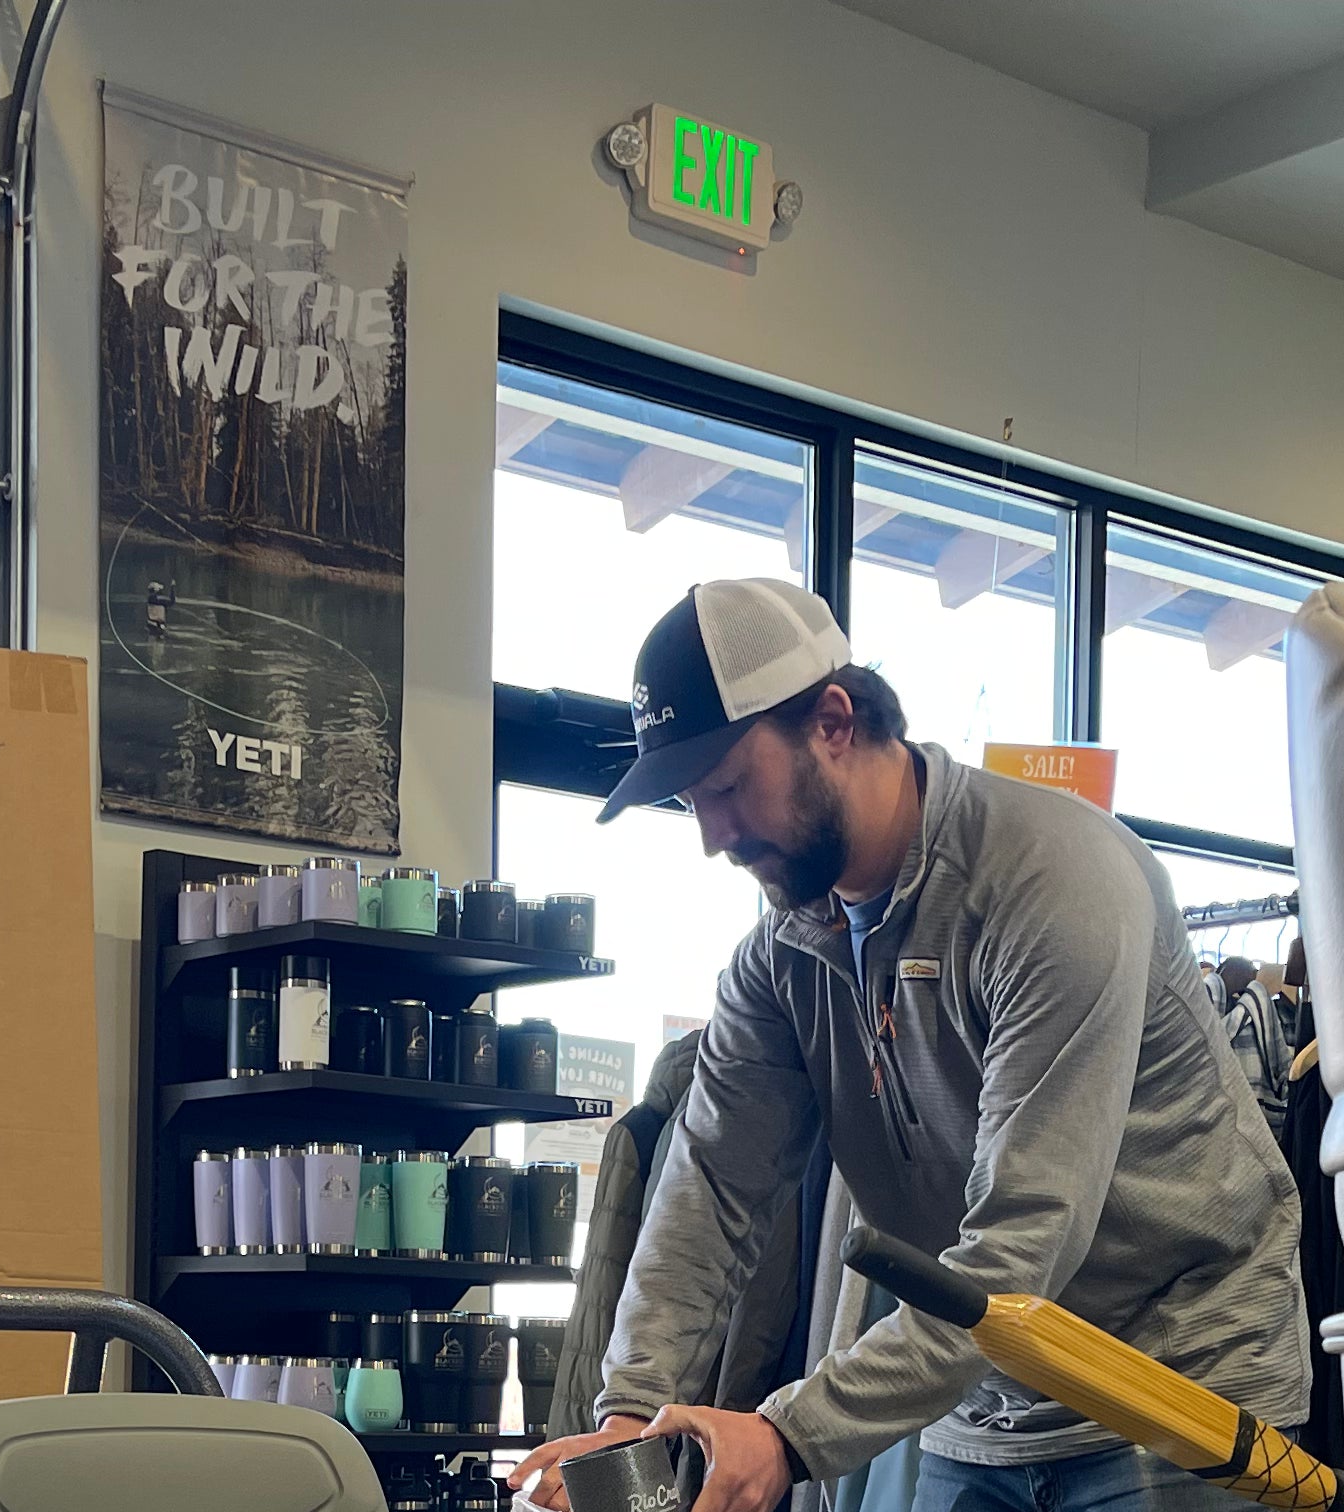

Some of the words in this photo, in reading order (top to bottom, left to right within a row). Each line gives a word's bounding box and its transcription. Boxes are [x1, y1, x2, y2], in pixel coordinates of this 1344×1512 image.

[673, 117, 759, 226] EXIT
[153, 164, 358, 250] BUILT
[112, 245, 256, 322] FOR
[264, 270, 395, 347] THE
[163, 323, 355, 427] WILD.
[207, 728, 302, 780] YETI
[1022, 754, 1076, 779] SALE!
[578, 955, 612, 974] YETI
[574, 1098, 608, 1115] YETI
